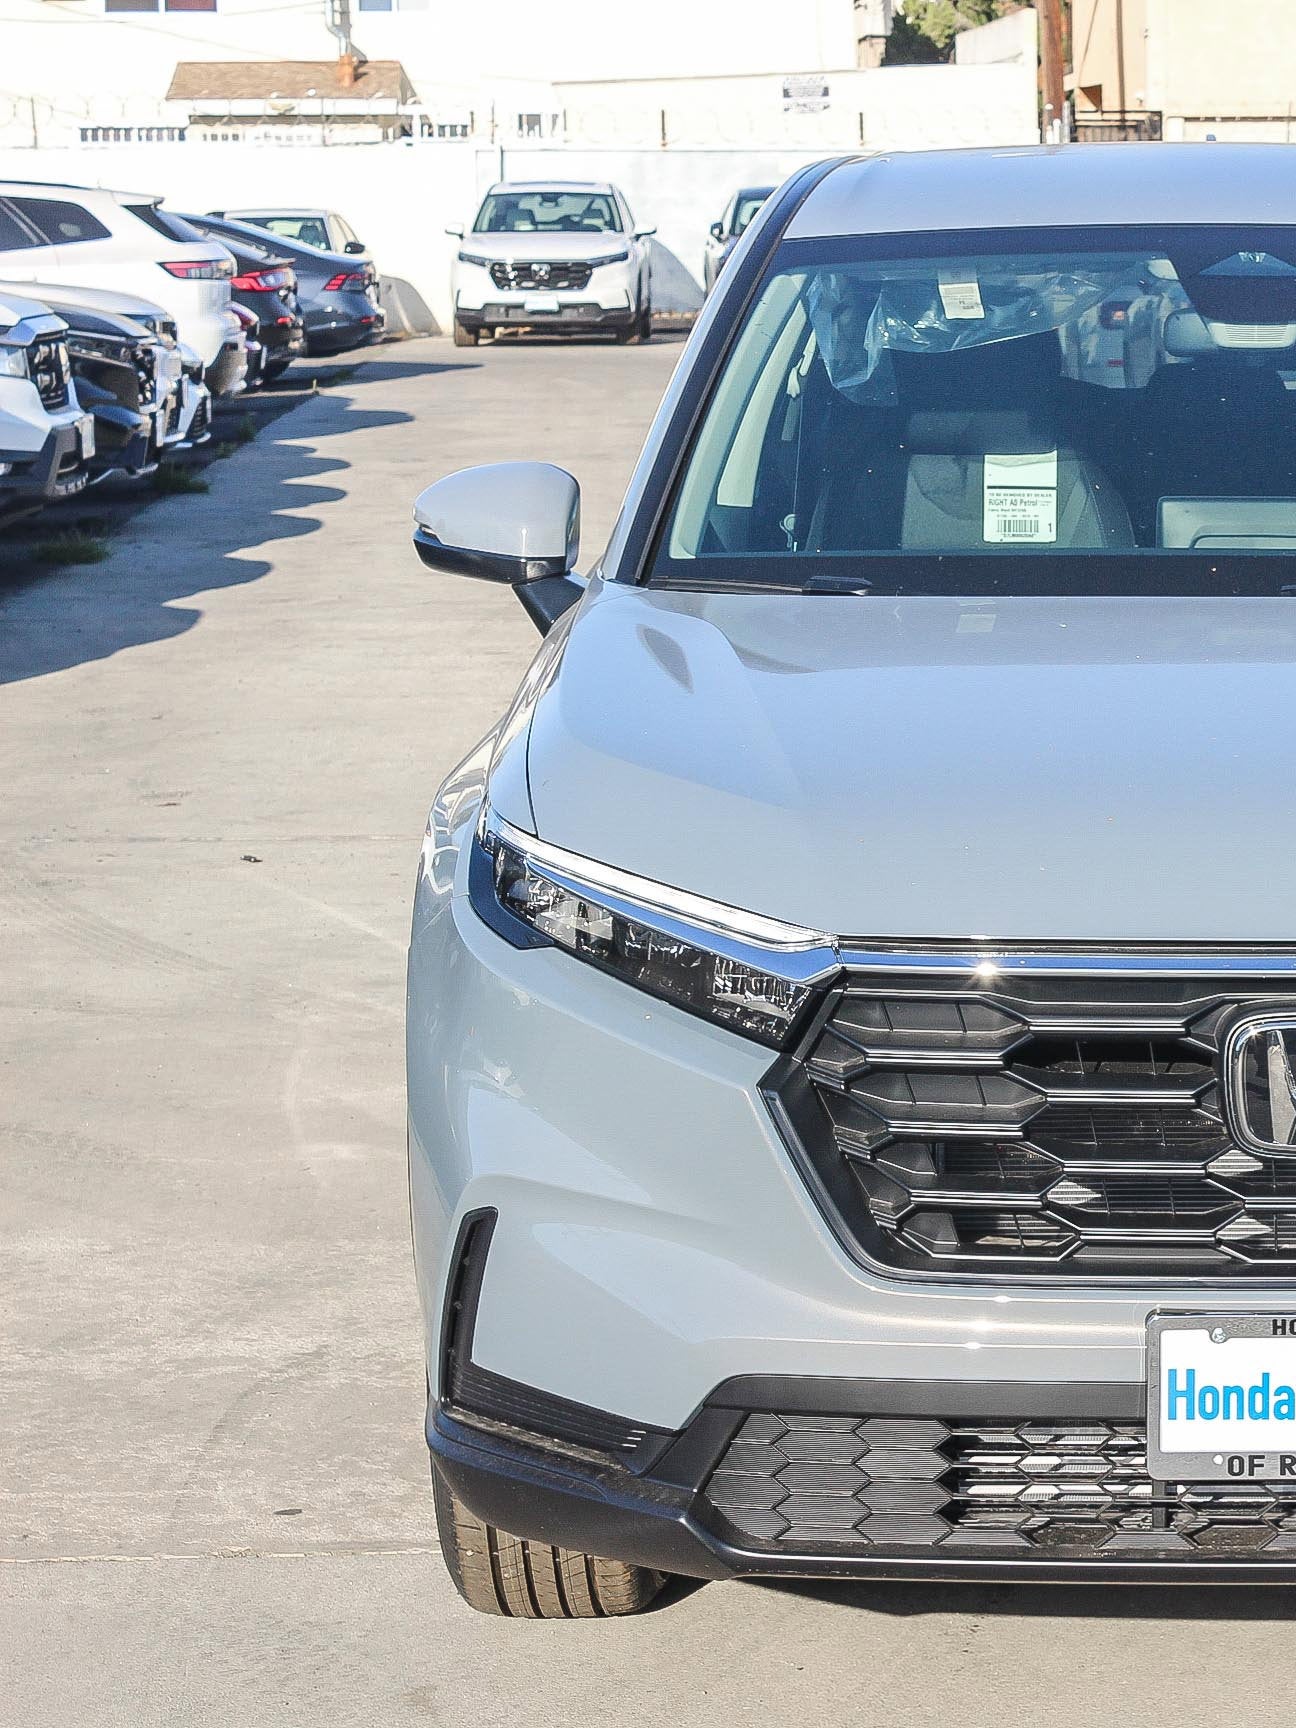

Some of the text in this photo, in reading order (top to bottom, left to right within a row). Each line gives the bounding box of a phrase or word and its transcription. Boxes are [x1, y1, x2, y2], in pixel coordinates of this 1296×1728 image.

[988, 499, 1008, 507] RIGHT
[1020, 499, 1038, 507] Petrol
[1048, 522, 1052, 533] 1
[1167, 1368, 1296, 1421] Honda
[1227, 1454, 1266, 1477] OF
